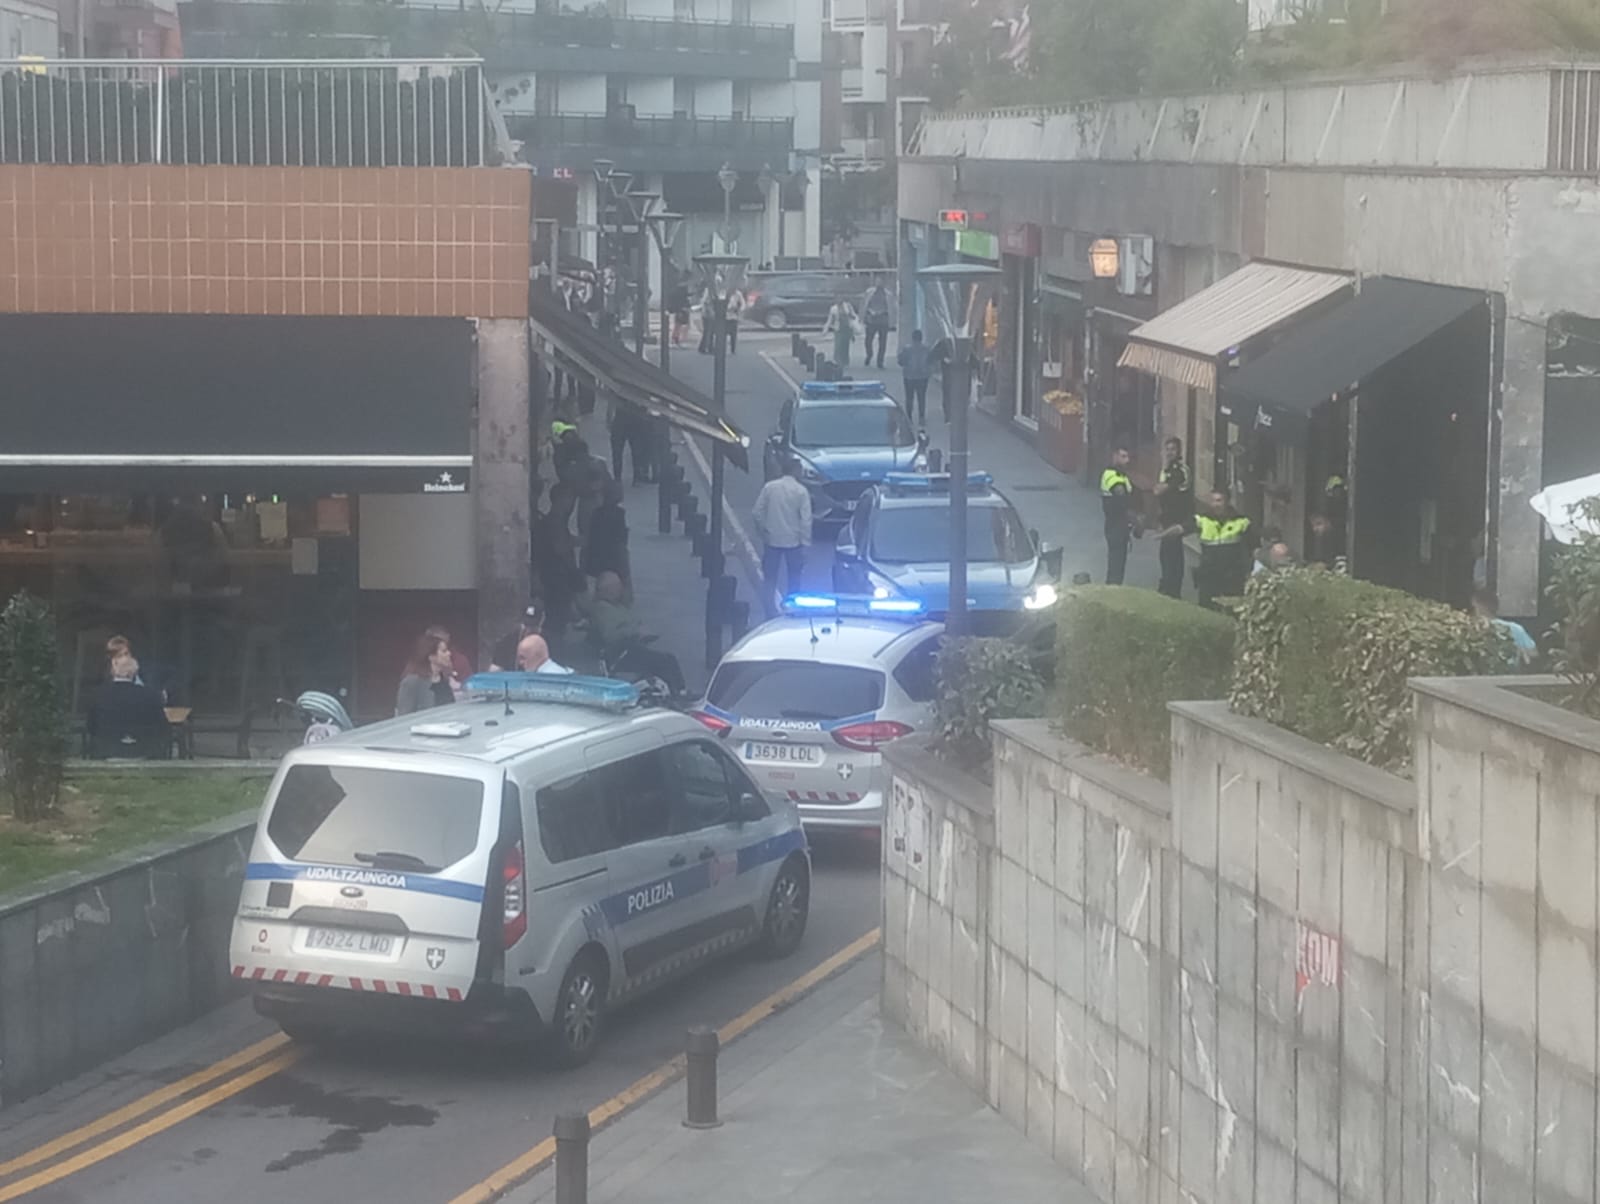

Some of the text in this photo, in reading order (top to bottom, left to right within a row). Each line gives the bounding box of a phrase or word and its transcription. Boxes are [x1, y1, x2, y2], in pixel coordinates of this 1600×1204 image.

[740, 717, 821, 731] UDALTZAINGOA
[755, 745, 815, 760] 3638 LDL
[306, 867, 406, 888] UDALTZAINGOA
[627, 880, 674, 914] POLIZIA
